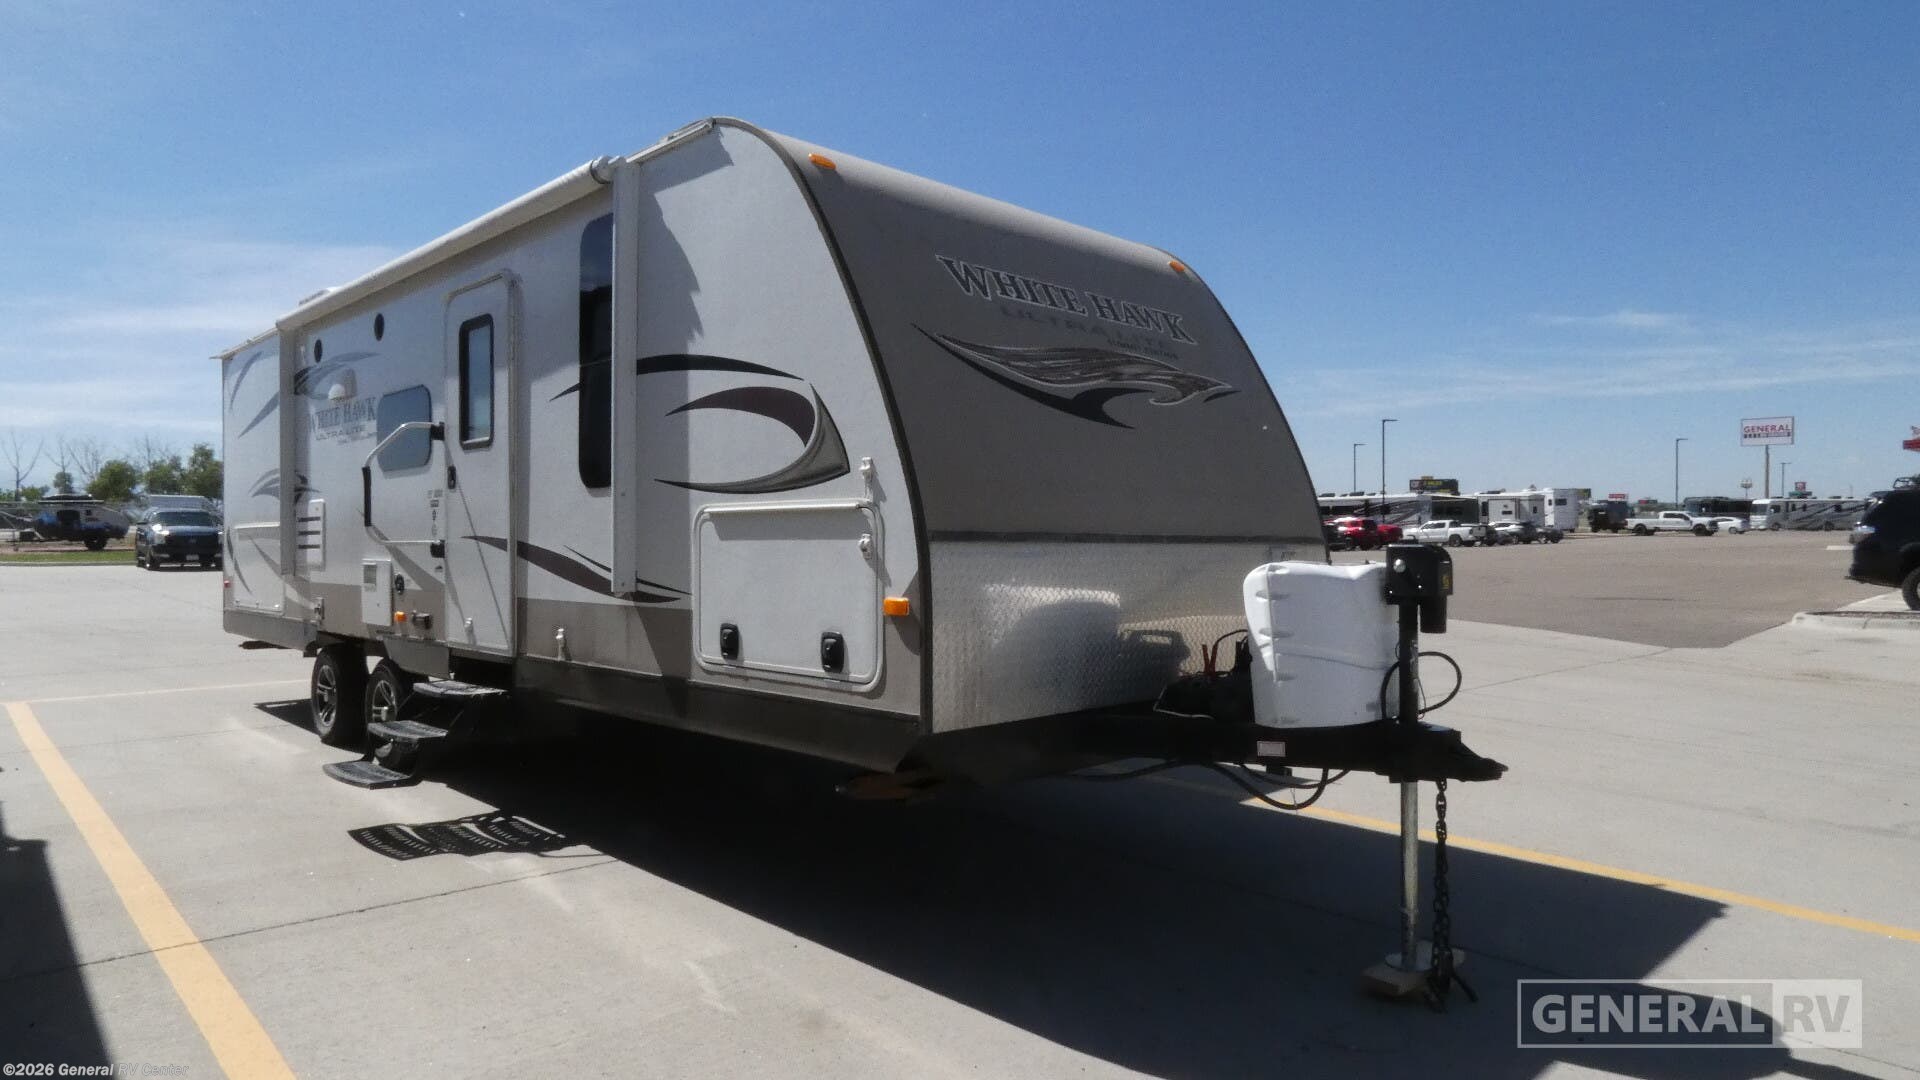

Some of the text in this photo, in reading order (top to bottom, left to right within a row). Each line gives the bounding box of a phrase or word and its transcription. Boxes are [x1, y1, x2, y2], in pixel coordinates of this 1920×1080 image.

[935, 253, 1198, 345] WHITE HAWK
[343, 397, 377, 423] HAWK
[1743, 424, 1791, 434] GENERAL
